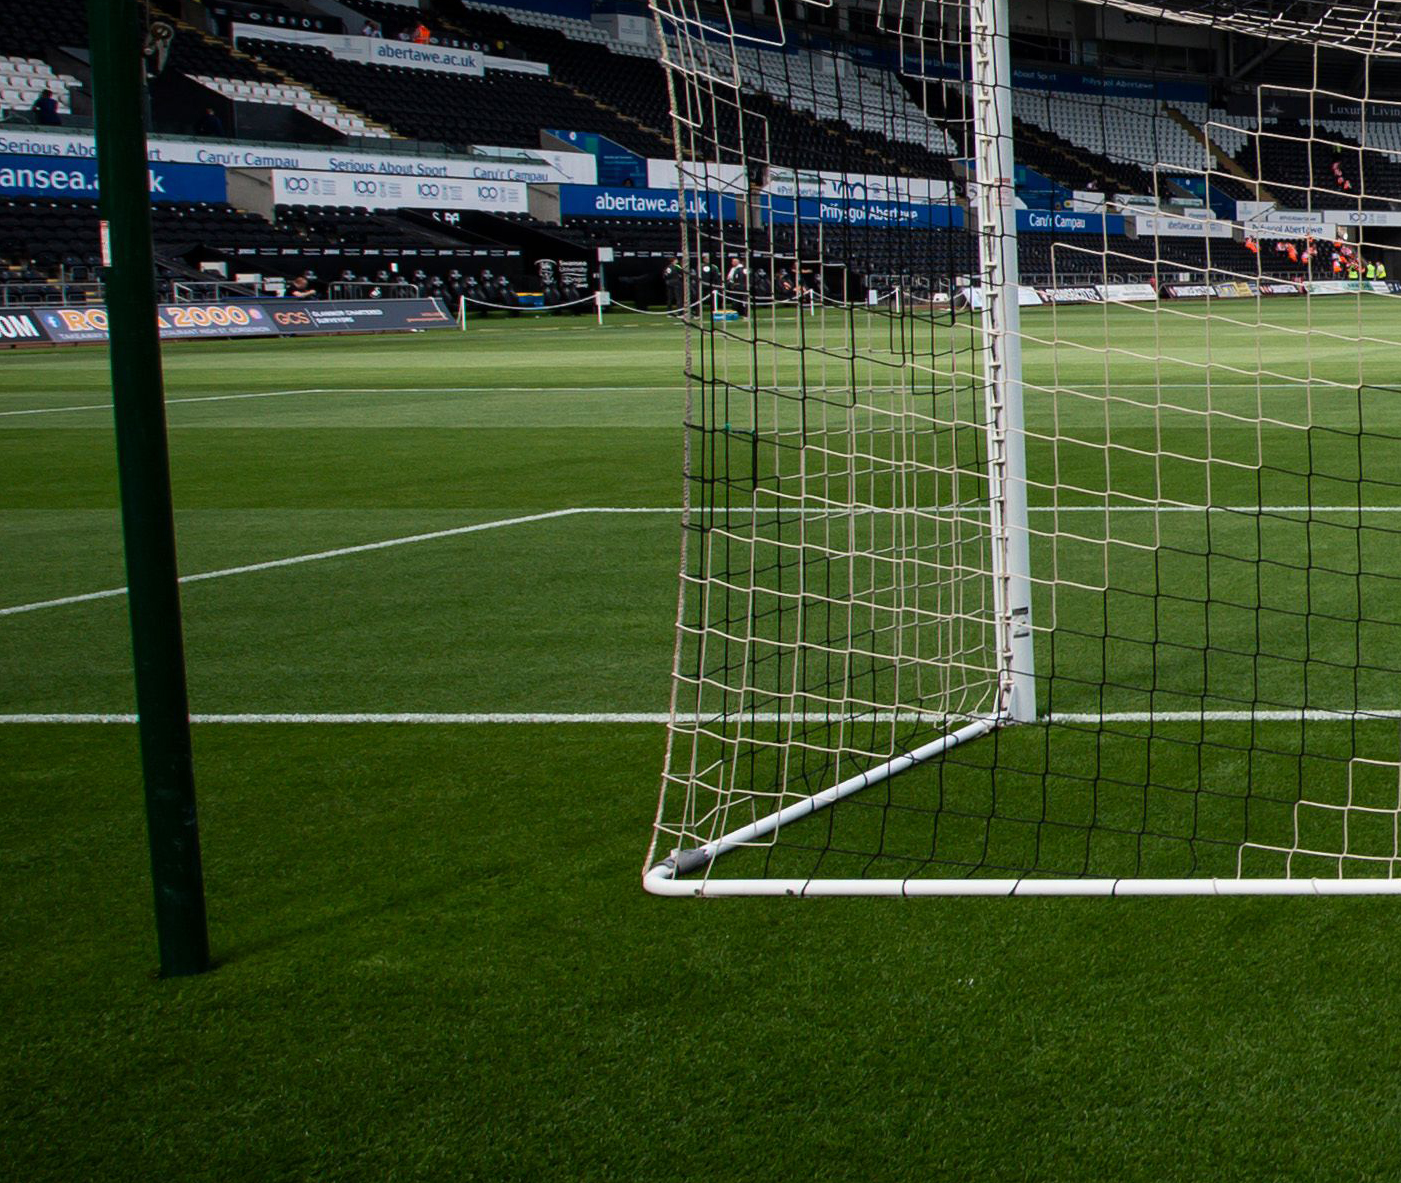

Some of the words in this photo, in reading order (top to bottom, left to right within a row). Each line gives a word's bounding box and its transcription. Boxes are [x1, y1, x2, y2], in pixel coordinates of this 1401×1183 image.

[377, 44, 476, 69] abertawe.ac.uk
[1329, 103, 1369, 118] Luxury
[0, 137, 60, 156] Serious
[197, 149, 240, 166] Caru'r
[245, 152, 299, 168] Campau
[329, 157, 375, 173] Serious
[379, 162, 414, 175] About
[417, 164, 447, 177] Sport
[472, 166, 504, 180] Caru'r
[507, 169, 549, 184] Campau
[1055, 213, 1086, 230] Campau
[167, 305, 250, 328] 2000
[274, 311, 311, 325] GCS
